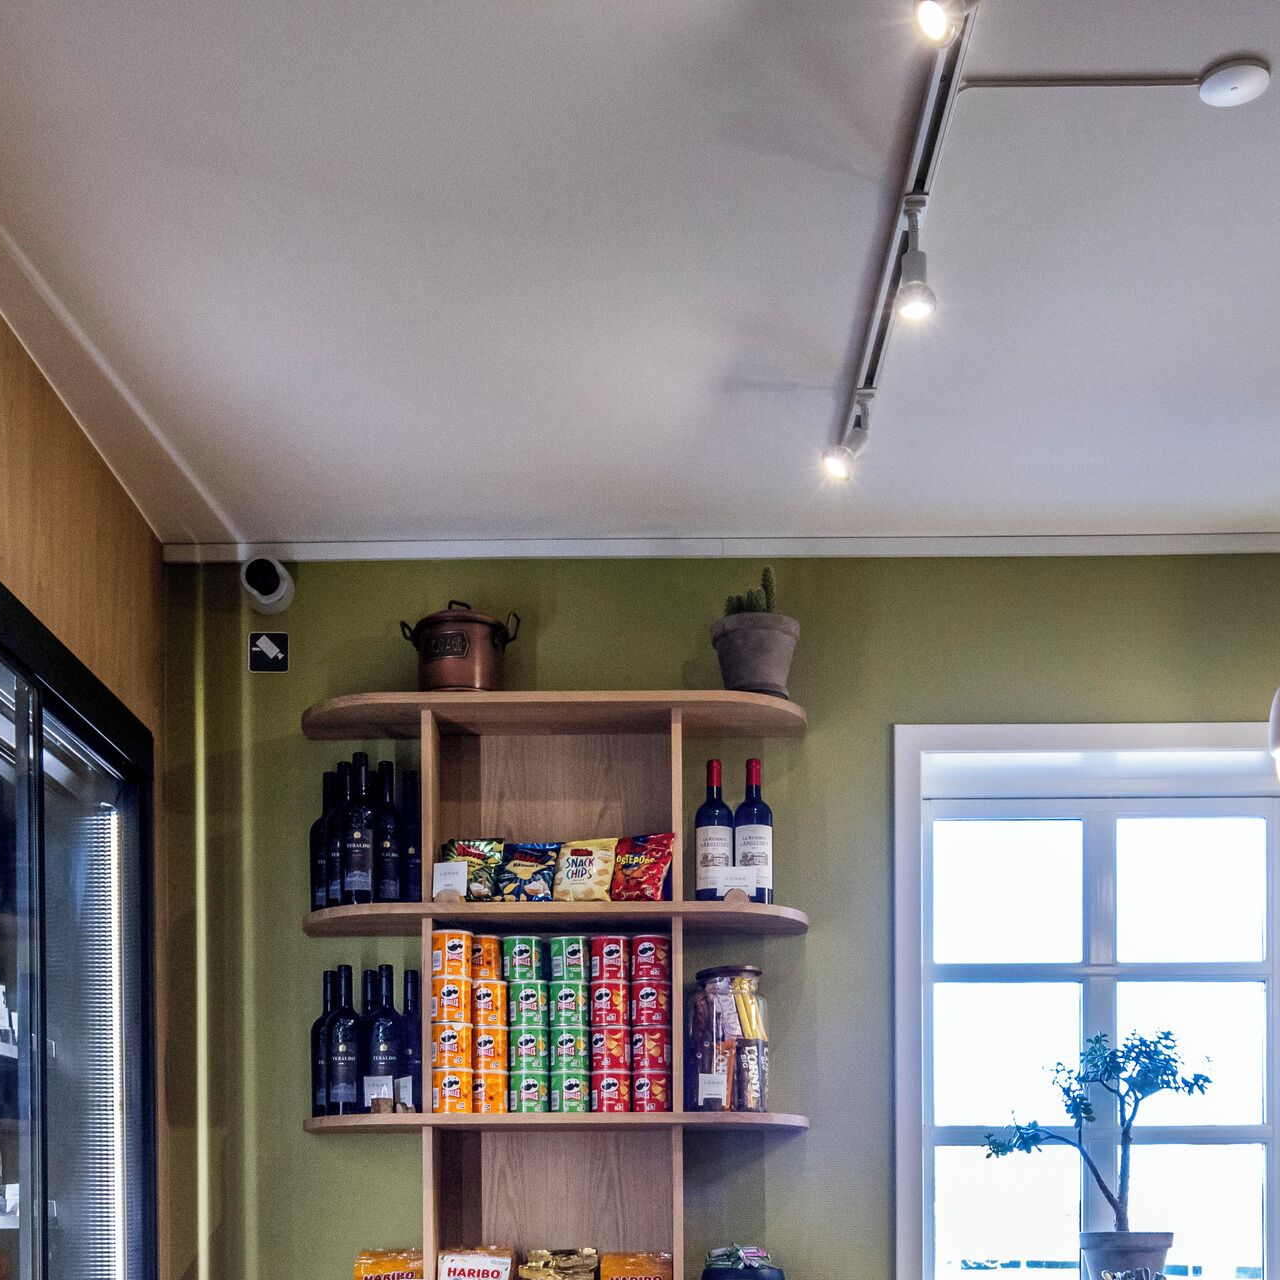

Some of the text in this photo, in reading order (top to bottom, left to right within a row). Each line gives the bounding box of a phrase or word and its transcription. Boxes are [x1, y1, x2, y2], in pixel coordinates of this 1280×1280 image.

[565, 857, 595, 869] SNACK
[566, 867, 593, 879] CHIPS
[447, 1267, 502, 1279] HARIBO
